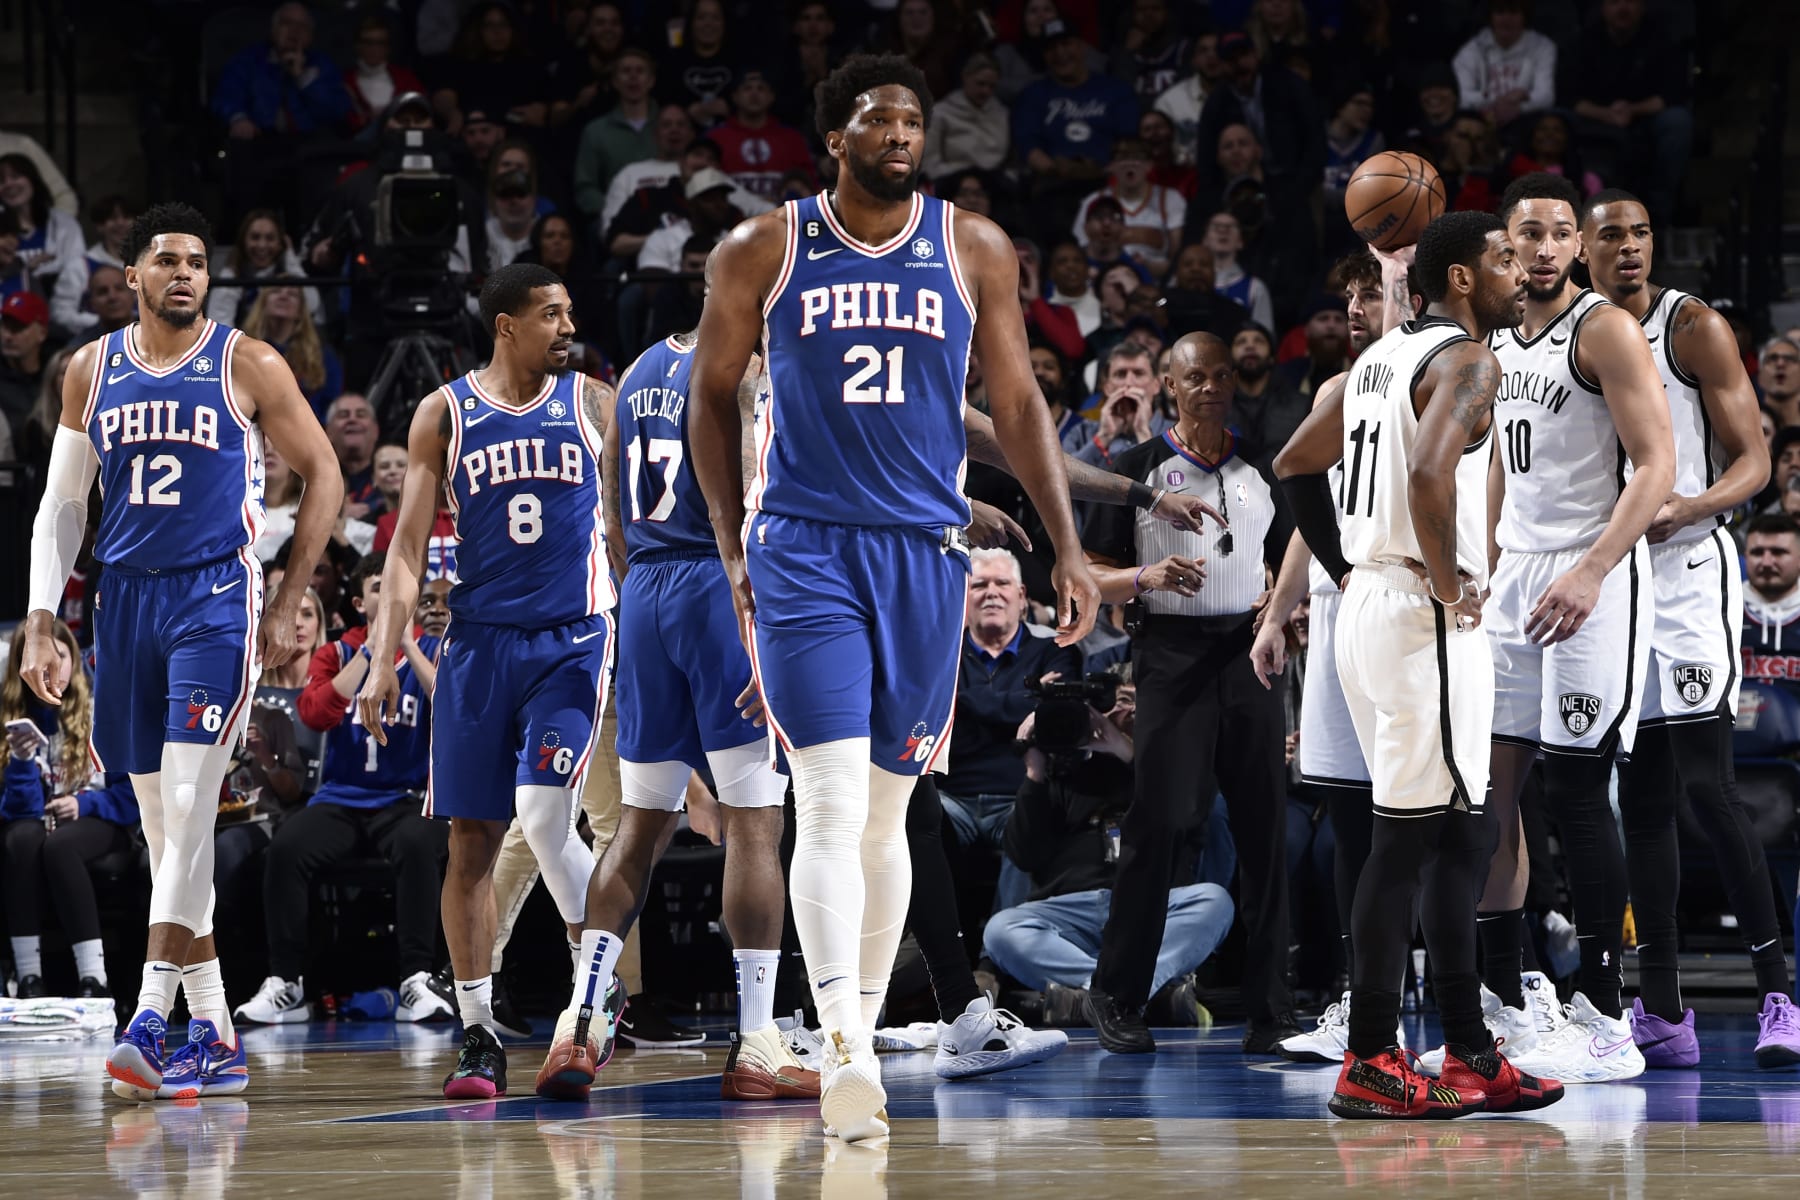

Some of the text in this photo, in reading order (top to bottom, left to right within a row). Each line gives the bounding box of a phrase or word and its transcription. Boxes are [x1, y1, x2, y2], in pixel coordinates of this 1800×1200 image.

[807, 221, 820, 238] 6
[904, 261, 944, 269] crypto.com
[799, 281, 946, 340] PHILA
[110, 352, 123, 368] 6
[842, 344, 905, 405] 21
[184, 375, 220, 383] crypto.com
[1494, 370, 1572, 415] OOKLYN
[463, 397, 476, 410] 6
[627, 387, 685, 427] TUCKER
[98, 400, 220, 453] PHILA
[541, 420, 576, 428] crypto.com
[1505, 418, 1532, 474] 10
[127, 453, 183, 507] 12
[461, 438, 585, 497] PHILA
[626, 435, 683, 523] 17
[1170, 472, 1182, 486] TB
[1346, 419, 1381, 518] 11
[507, 493, 543, 545] 8
[1675, 665, 1712, 684] NETS
[1560, 695, 1599, 714] NETS
[1689, 684, 1697, 700] B
[184, 702, 223, 733] 76
[1574, 714, 1582, 730] B
[364, 735, 379, 773] 1
[535, 744, 574, 775] 76
[896, 735, 935, 763] 76
